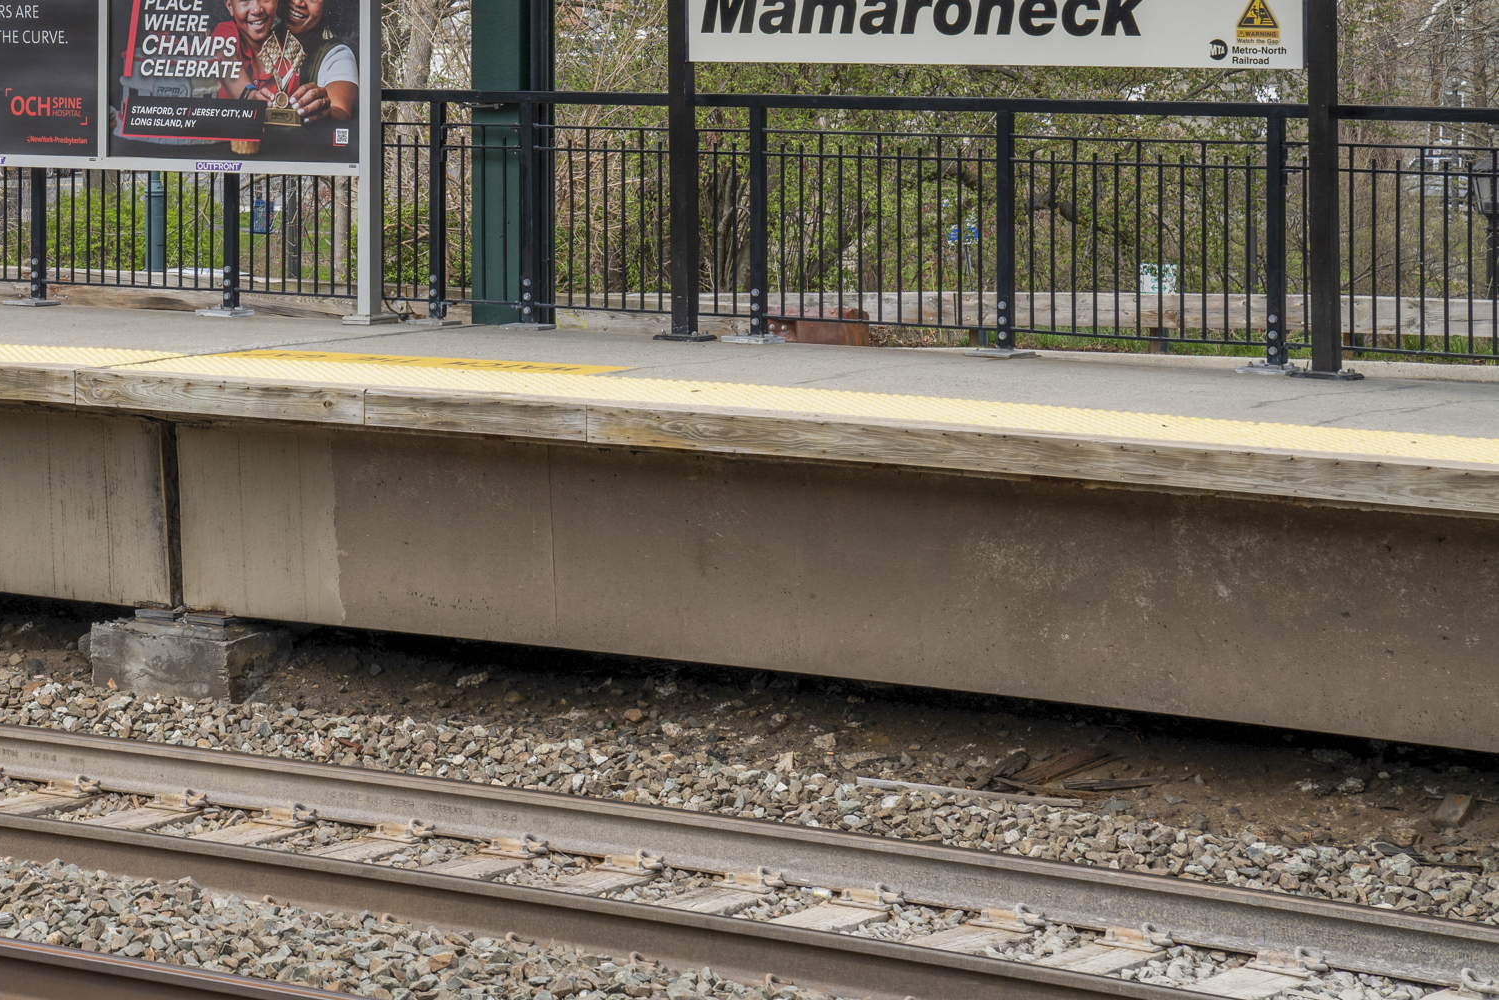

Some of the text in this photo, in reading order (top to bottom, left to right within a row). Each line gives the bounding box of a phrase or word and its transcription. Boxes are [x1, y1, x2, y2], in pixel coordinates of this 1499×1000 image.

[15, 5, 39, 18] ARE
[144, 14, 210, 32] WHERE
[22, 30, 68, 44] CURVE.
[142, 35, 237, 57] CHAMPS
[1210, 43, 1225, 56] MTA
[1232, 46, 1287, 54] Metro-North
[1232, 57, 1269, 65] Railroad
[140, 59, 242, 78] CELEBRATE
[157, 86, 180, 95] RPM
[10, 96, 50, 116] OCH
[52, 97, 82, 109] SPINE
[131, 106, 253, 119] STAMFORD, CT JERSEY CITY, NJ
[130, 118, 196, 129] LONG ISLAND, NY
[30, 136, 88, 145] NewYork-Presbyterian
[197, 162, 241, 171] OUTFRONT
